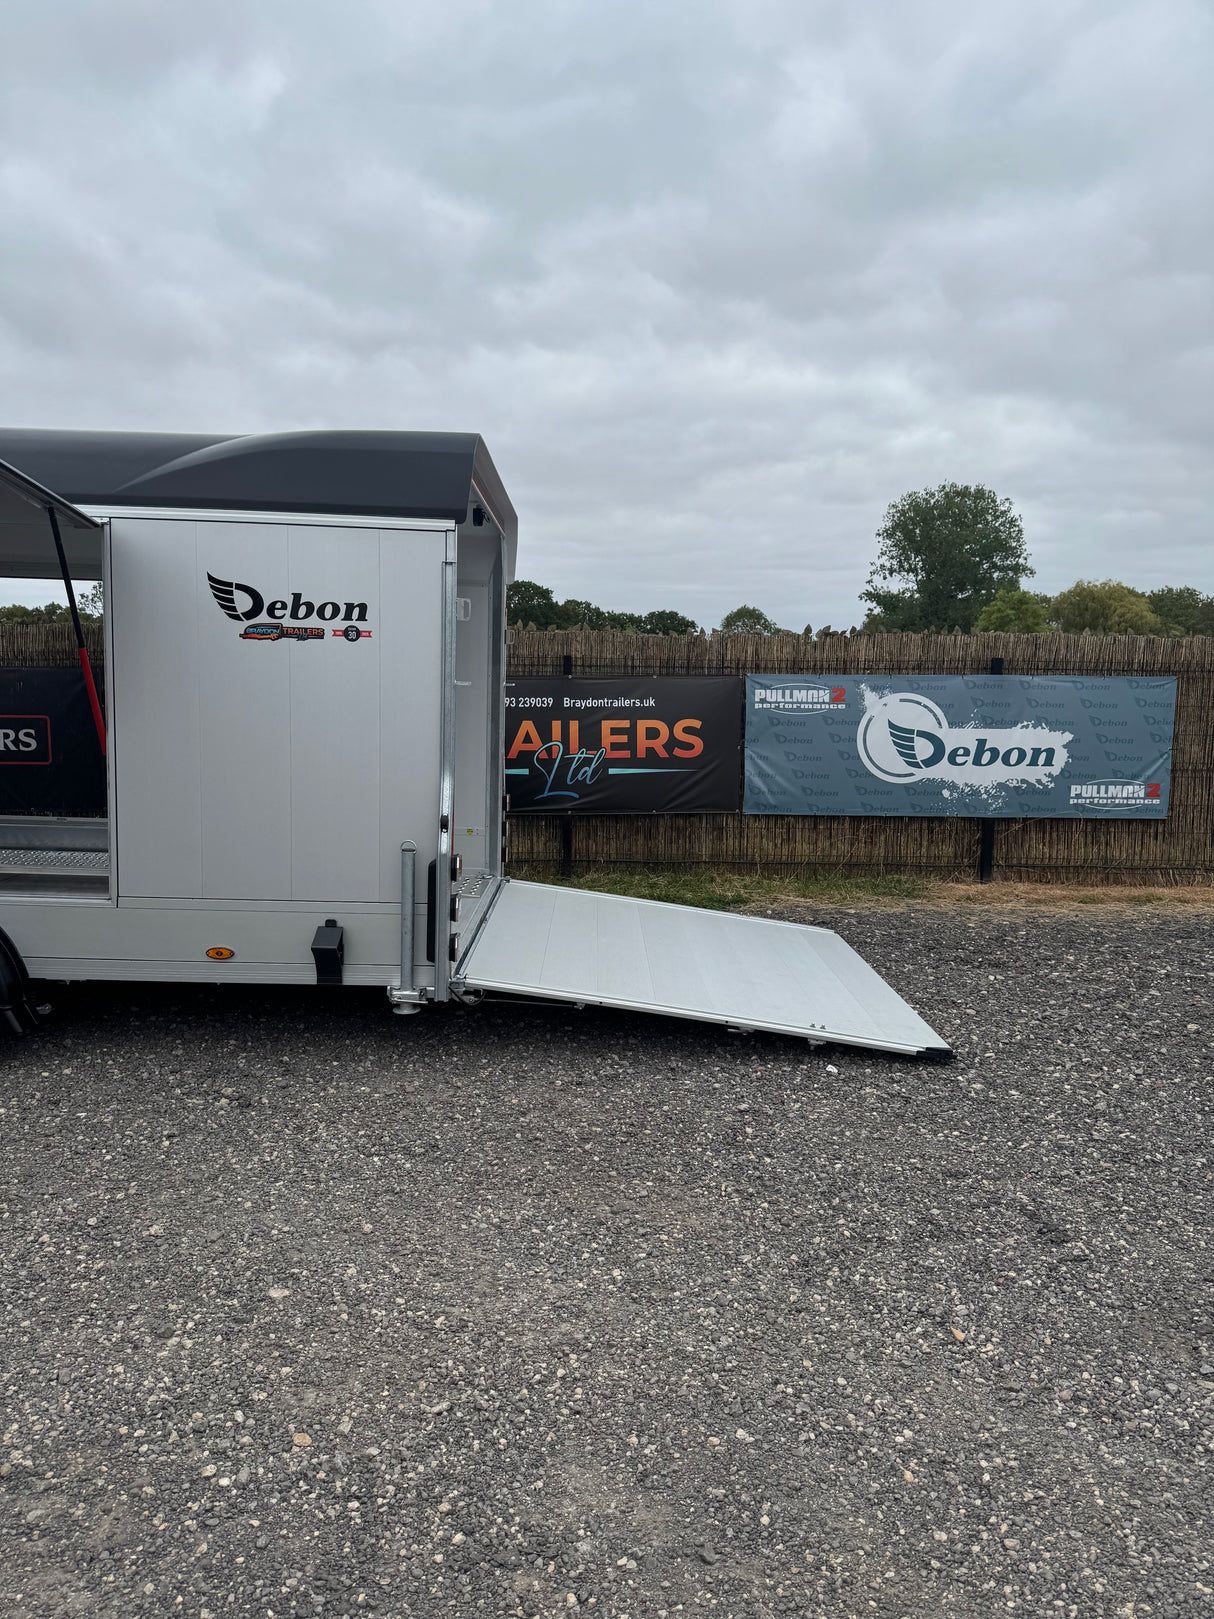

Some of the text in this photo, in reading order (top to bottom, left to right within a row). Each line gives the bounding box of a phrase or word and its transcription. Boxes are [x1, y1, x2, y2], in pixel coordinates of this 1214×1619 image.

[206, 571, 368, 622] Debon
[283, 627, 324, 636] TRAILERS
[348, 631, 357, 640] 30
[505, 697, 655, 709] 93 239039 Braydontrailers.uk
[0, 728, 37, 751] RS
[507, 718, 704, 759] AILERS
[887, 718, 1056, 769] Debon
[533, 741, 606, 799] Ltd
